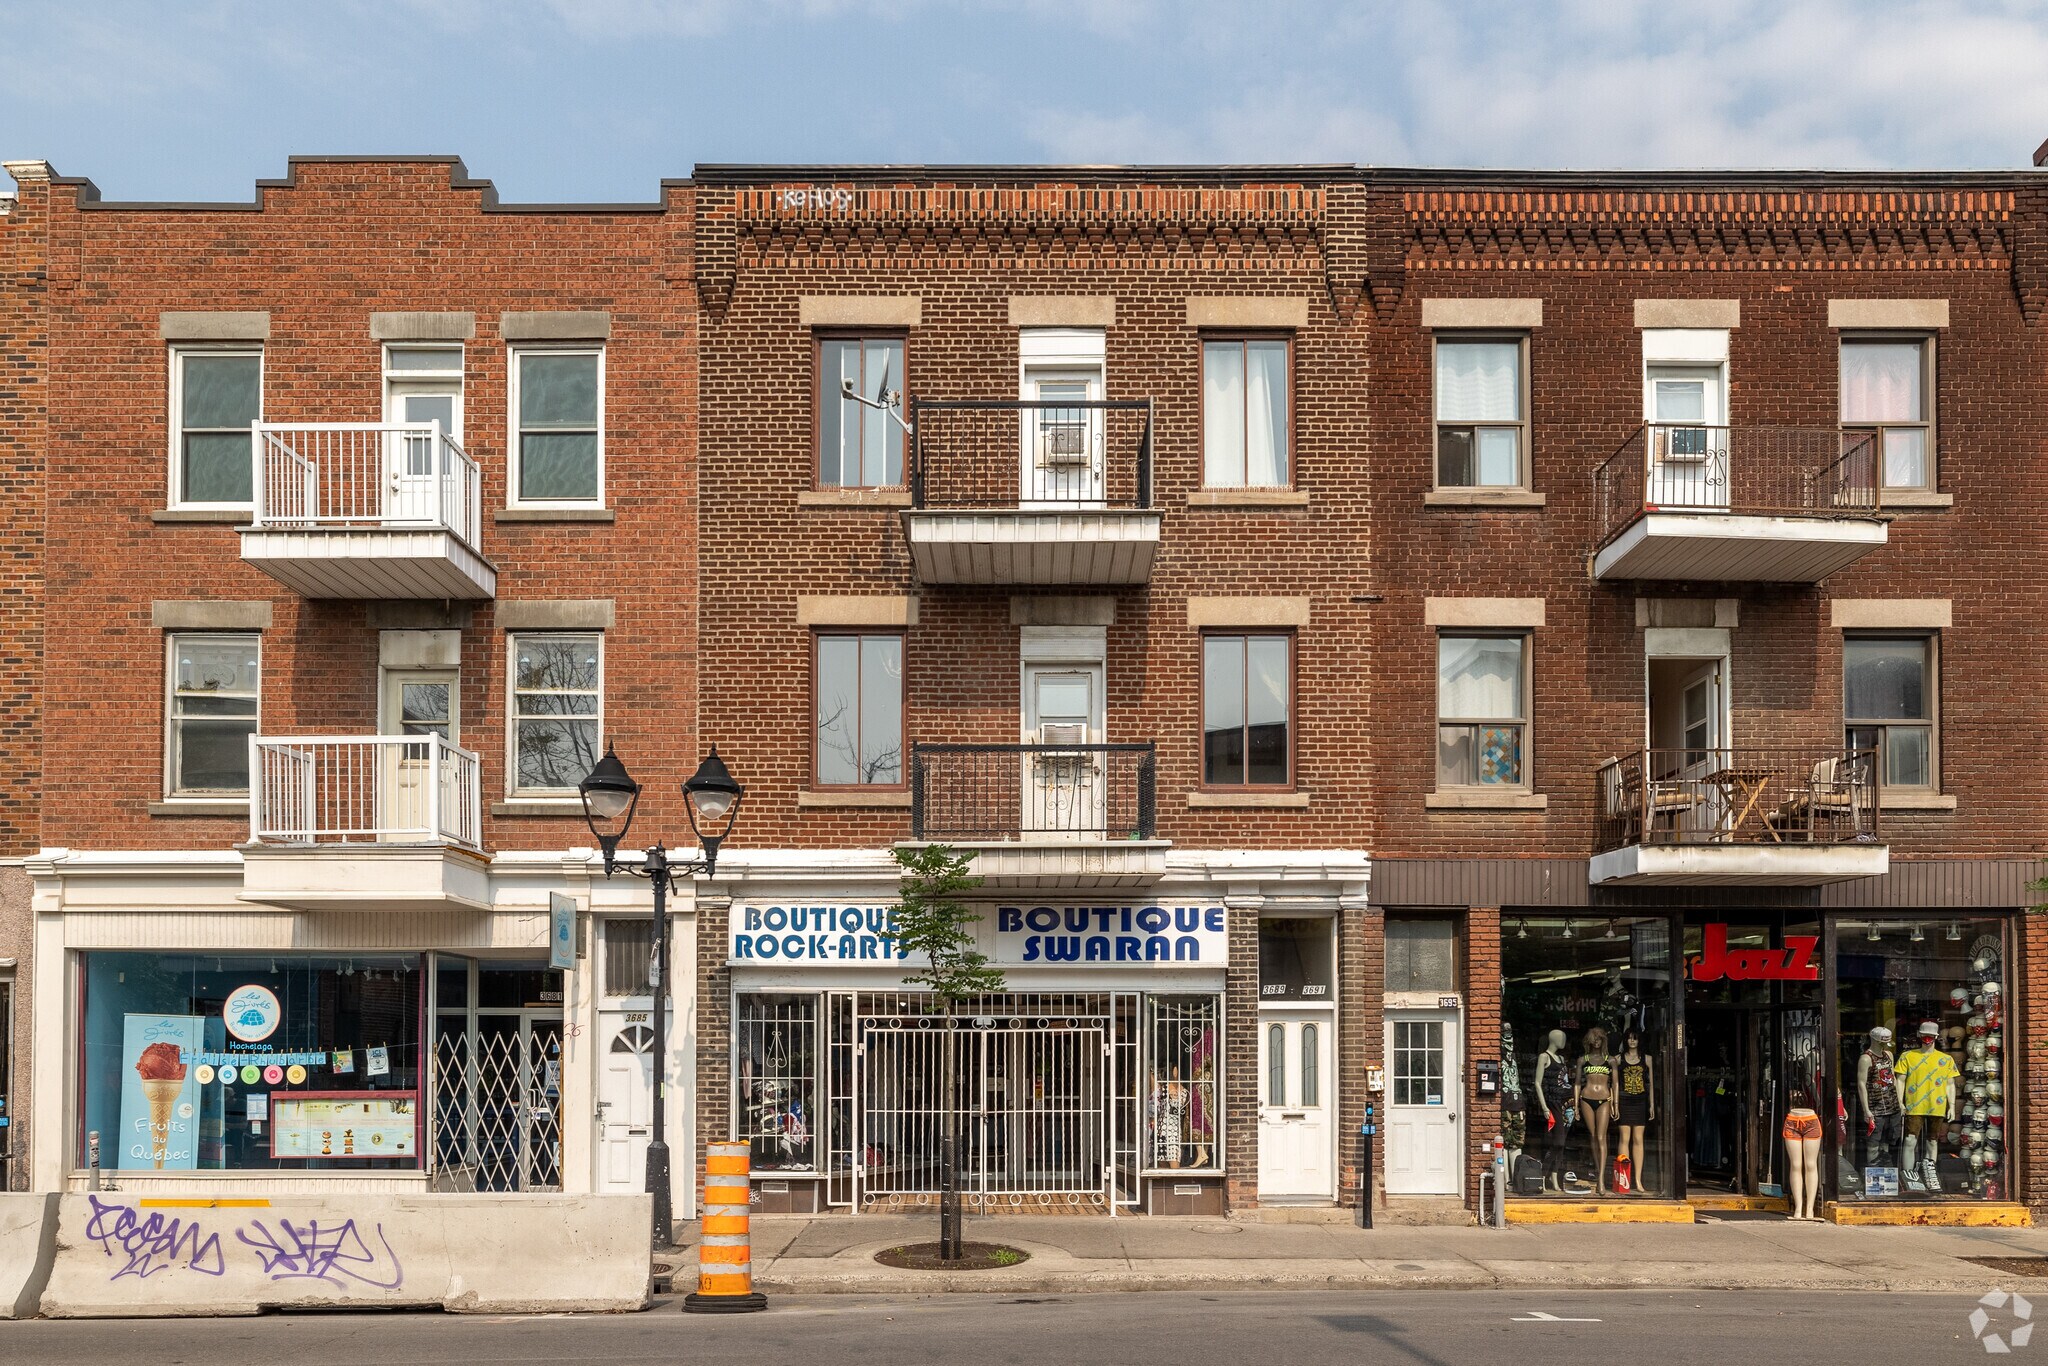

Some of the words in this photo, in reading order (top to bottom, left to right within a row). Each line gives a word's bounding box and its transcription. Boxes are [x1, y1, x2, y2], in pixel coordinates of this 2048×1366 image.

[999, 907, 1224, 934] BOUTIQUE
[1023, 935, 1200, 962] SWARAN
[1263, 985, 1286, 994] 3689
[1302, 985, 1325, 994] 3691
[1439, 998, 1459, 1008] 3695
[625, 1013, 648, 1023] 3685
[229, 1041, 272, 1051] Hochelaga
[134, 1117, 186, 1134] Fruits
[152, 1134, 166, 1143] du
[130, 1144, 190, 1161] Québec
